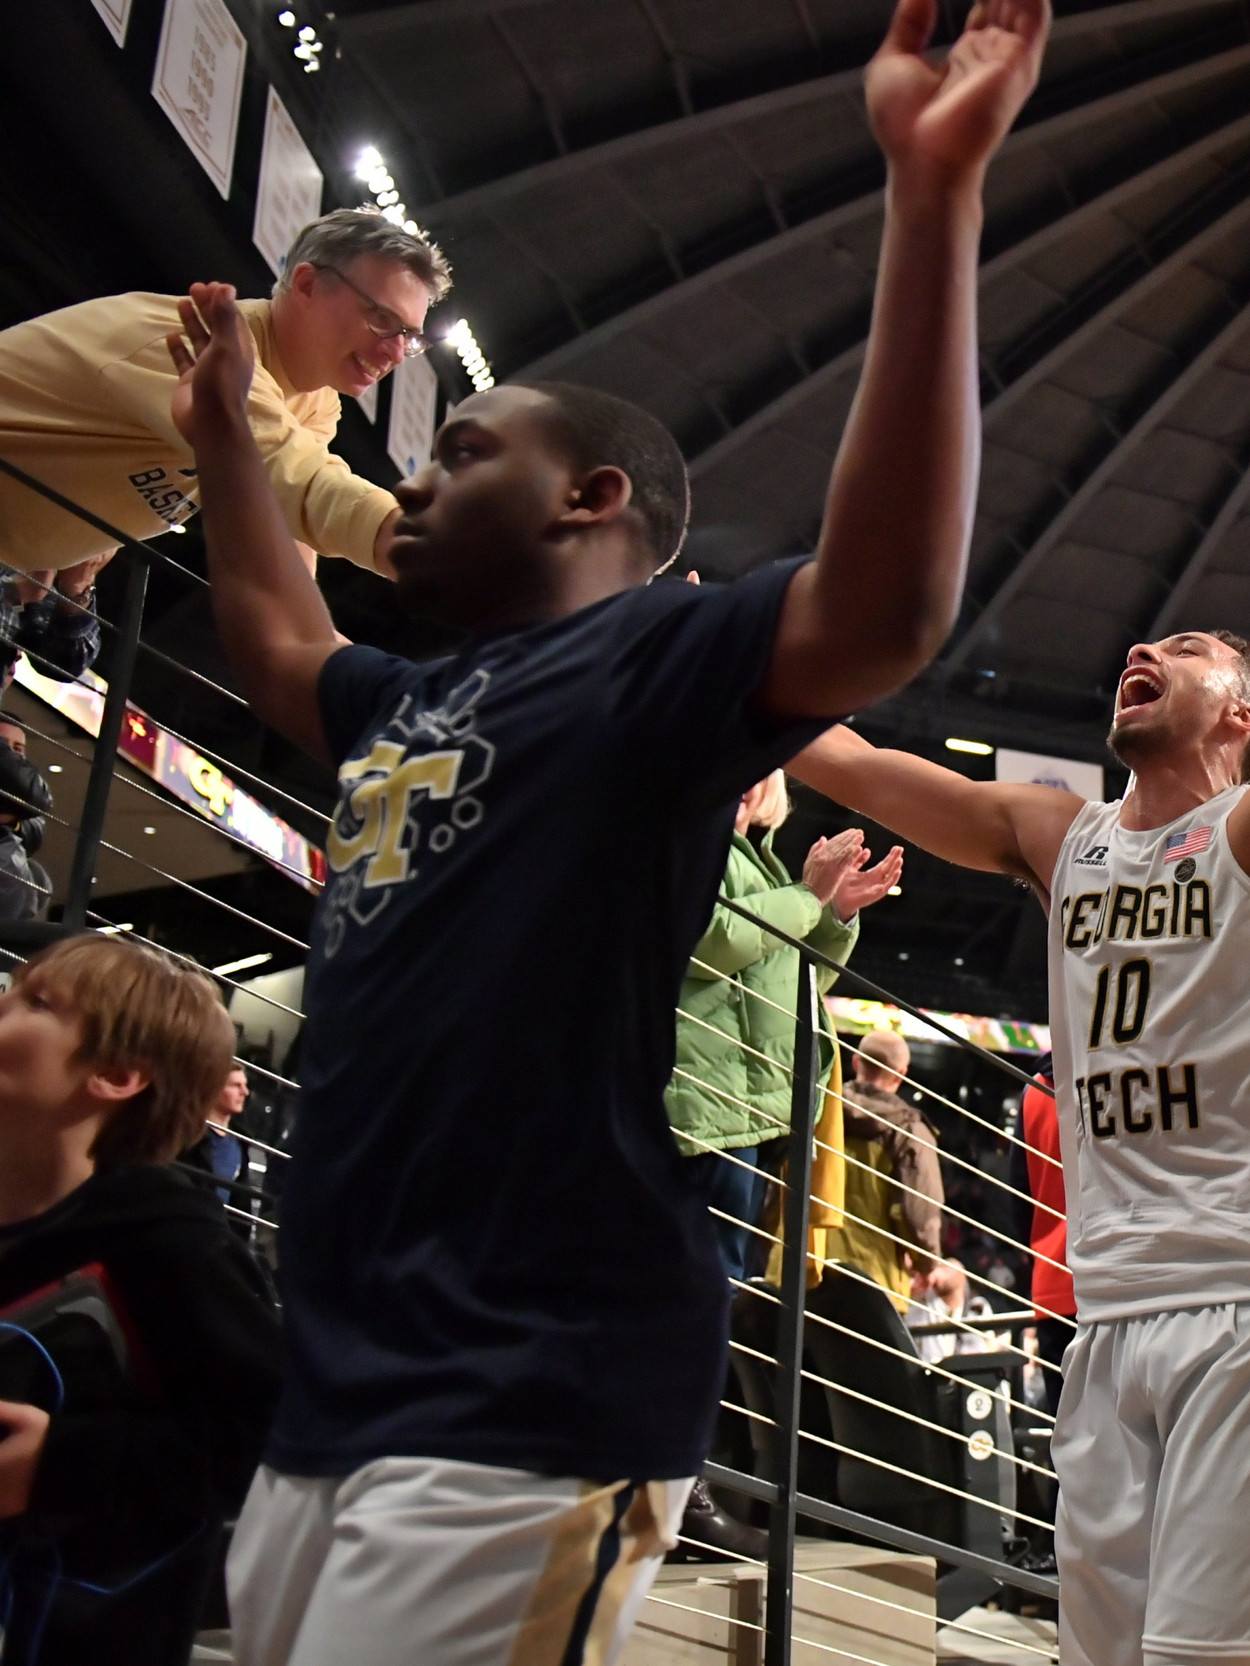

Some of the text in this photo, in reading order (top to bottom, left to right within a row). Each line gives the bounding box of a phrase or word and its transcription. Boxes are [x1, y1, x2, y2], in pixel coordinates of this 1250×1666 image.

[1073, 858, 1107, 867] RUSSELL
[1087, 956, 1152, 1053] 10
[1075, 1062, 1200, 1138] TECH
